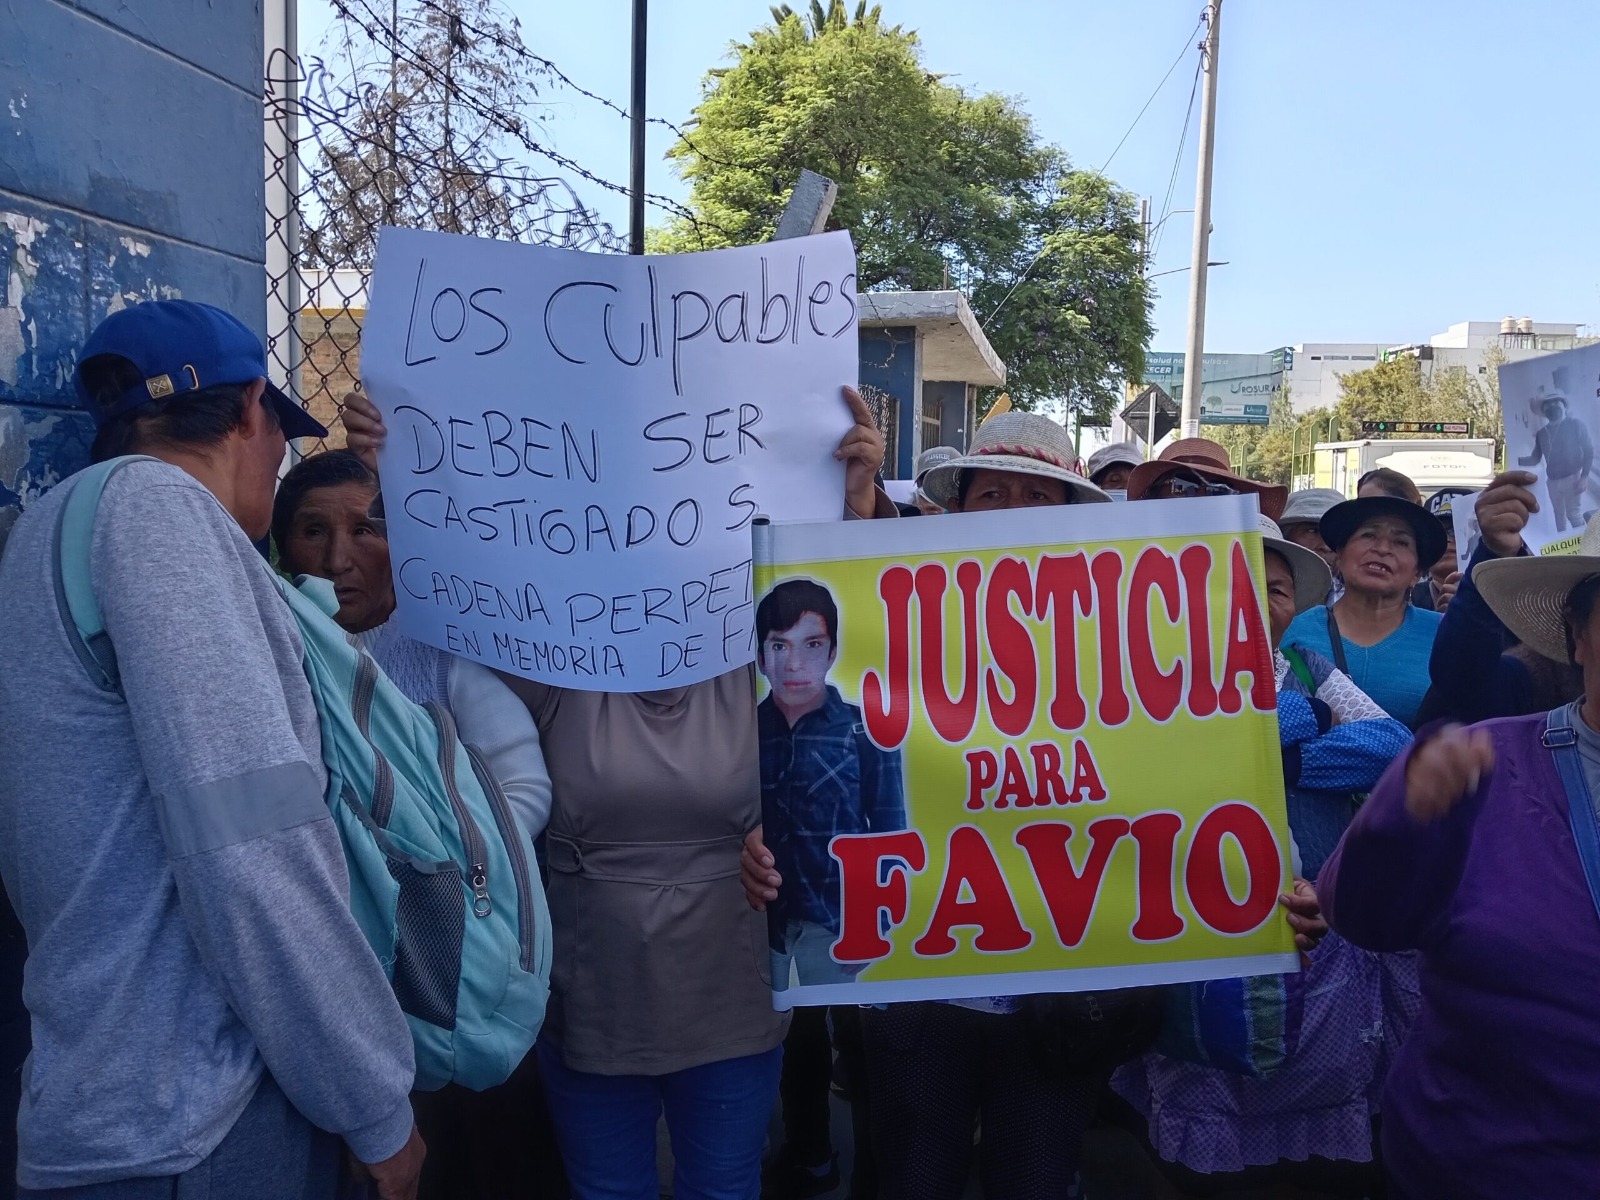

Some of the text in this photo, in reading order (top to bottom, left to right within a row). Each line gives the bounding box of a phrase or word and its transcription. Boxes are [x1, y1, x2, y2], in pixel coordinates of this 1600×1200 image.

[544, 254, 857, 396] Culpables
[1145, 366, 1172, 374] ECER
[1230, 381, 1270, 394] UROSUR
[393, 402, 768, 483] DEBEN SER
[399, 556, 553, 626] CADENA
[445, 623, 481, 657] EN
[492, 631, 628, 679] MEMORIA
[657, 634, 704, 679] DE
[862, 539, 1278, 751] JUSTICIA
[965, 738, 1108, 811] PARA
[829, 802, 1283, 963] FAVIO
